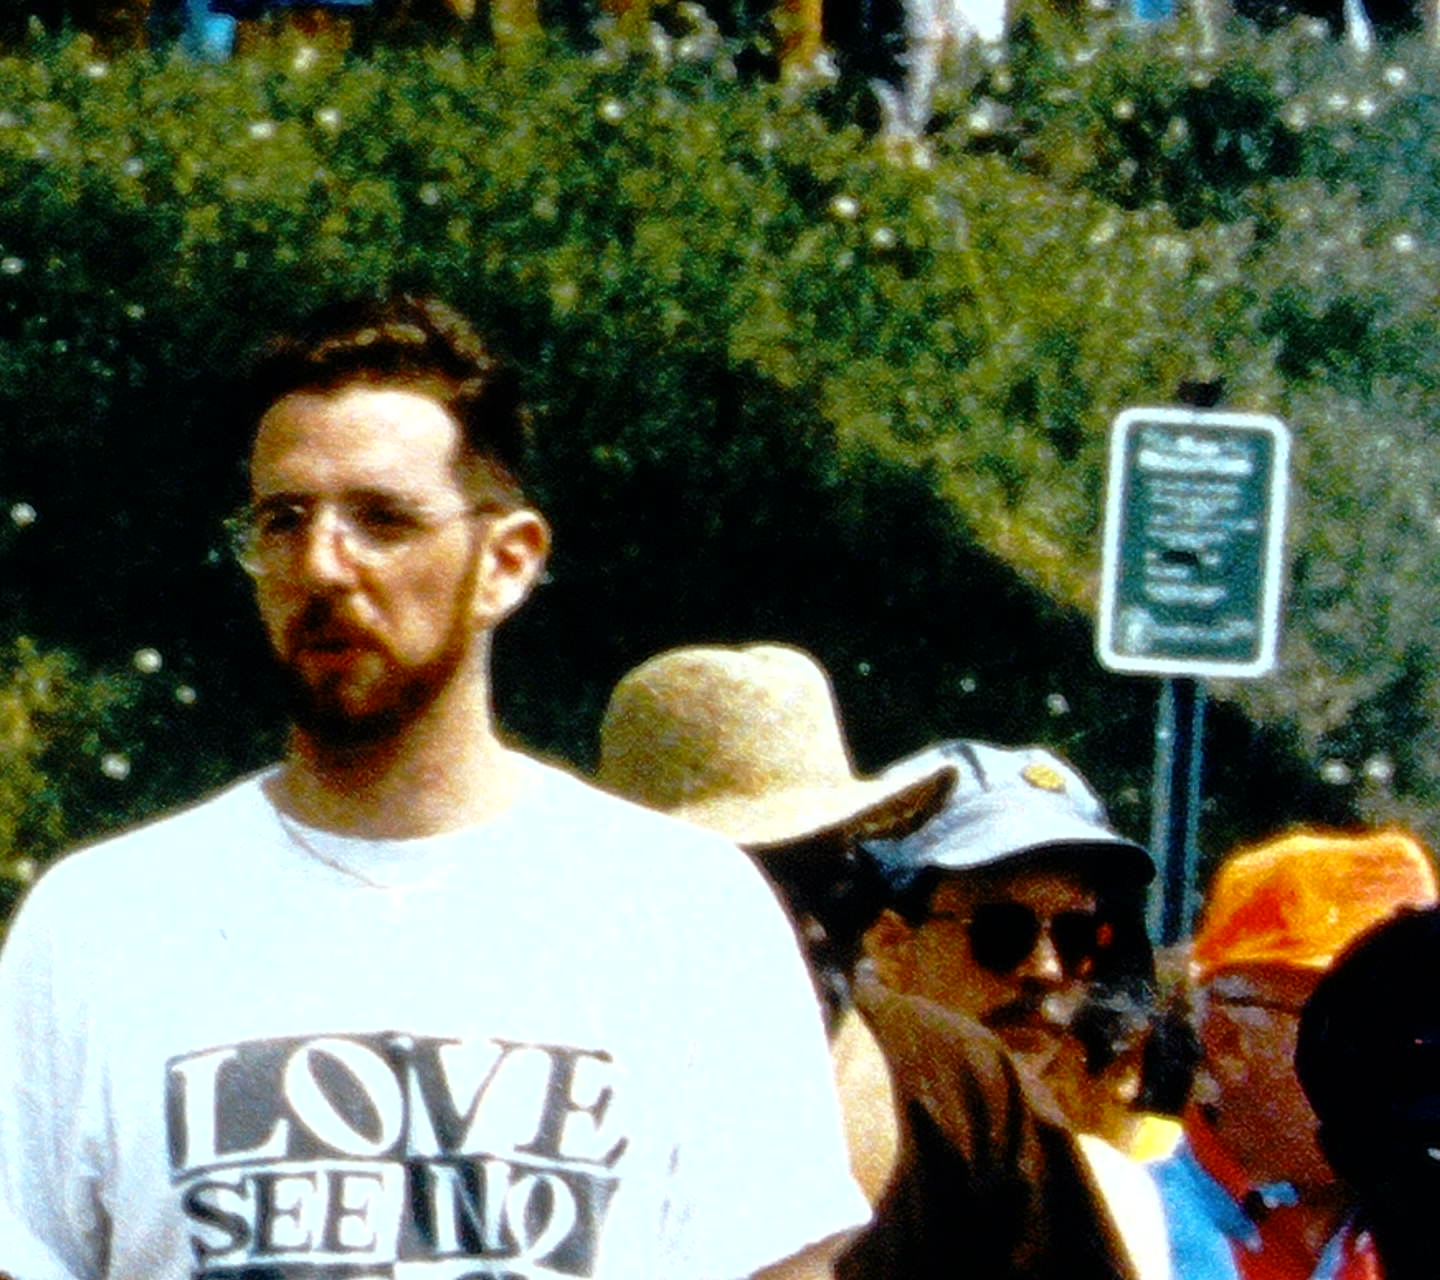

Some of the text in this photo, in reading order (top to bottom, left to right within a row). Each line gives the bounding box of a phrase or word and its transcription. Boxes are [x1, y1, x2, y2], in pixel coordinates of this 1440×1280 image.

[168, 1032, 630, 1174] LOVE
[182, 1158, 592, 1270] SEE NO
